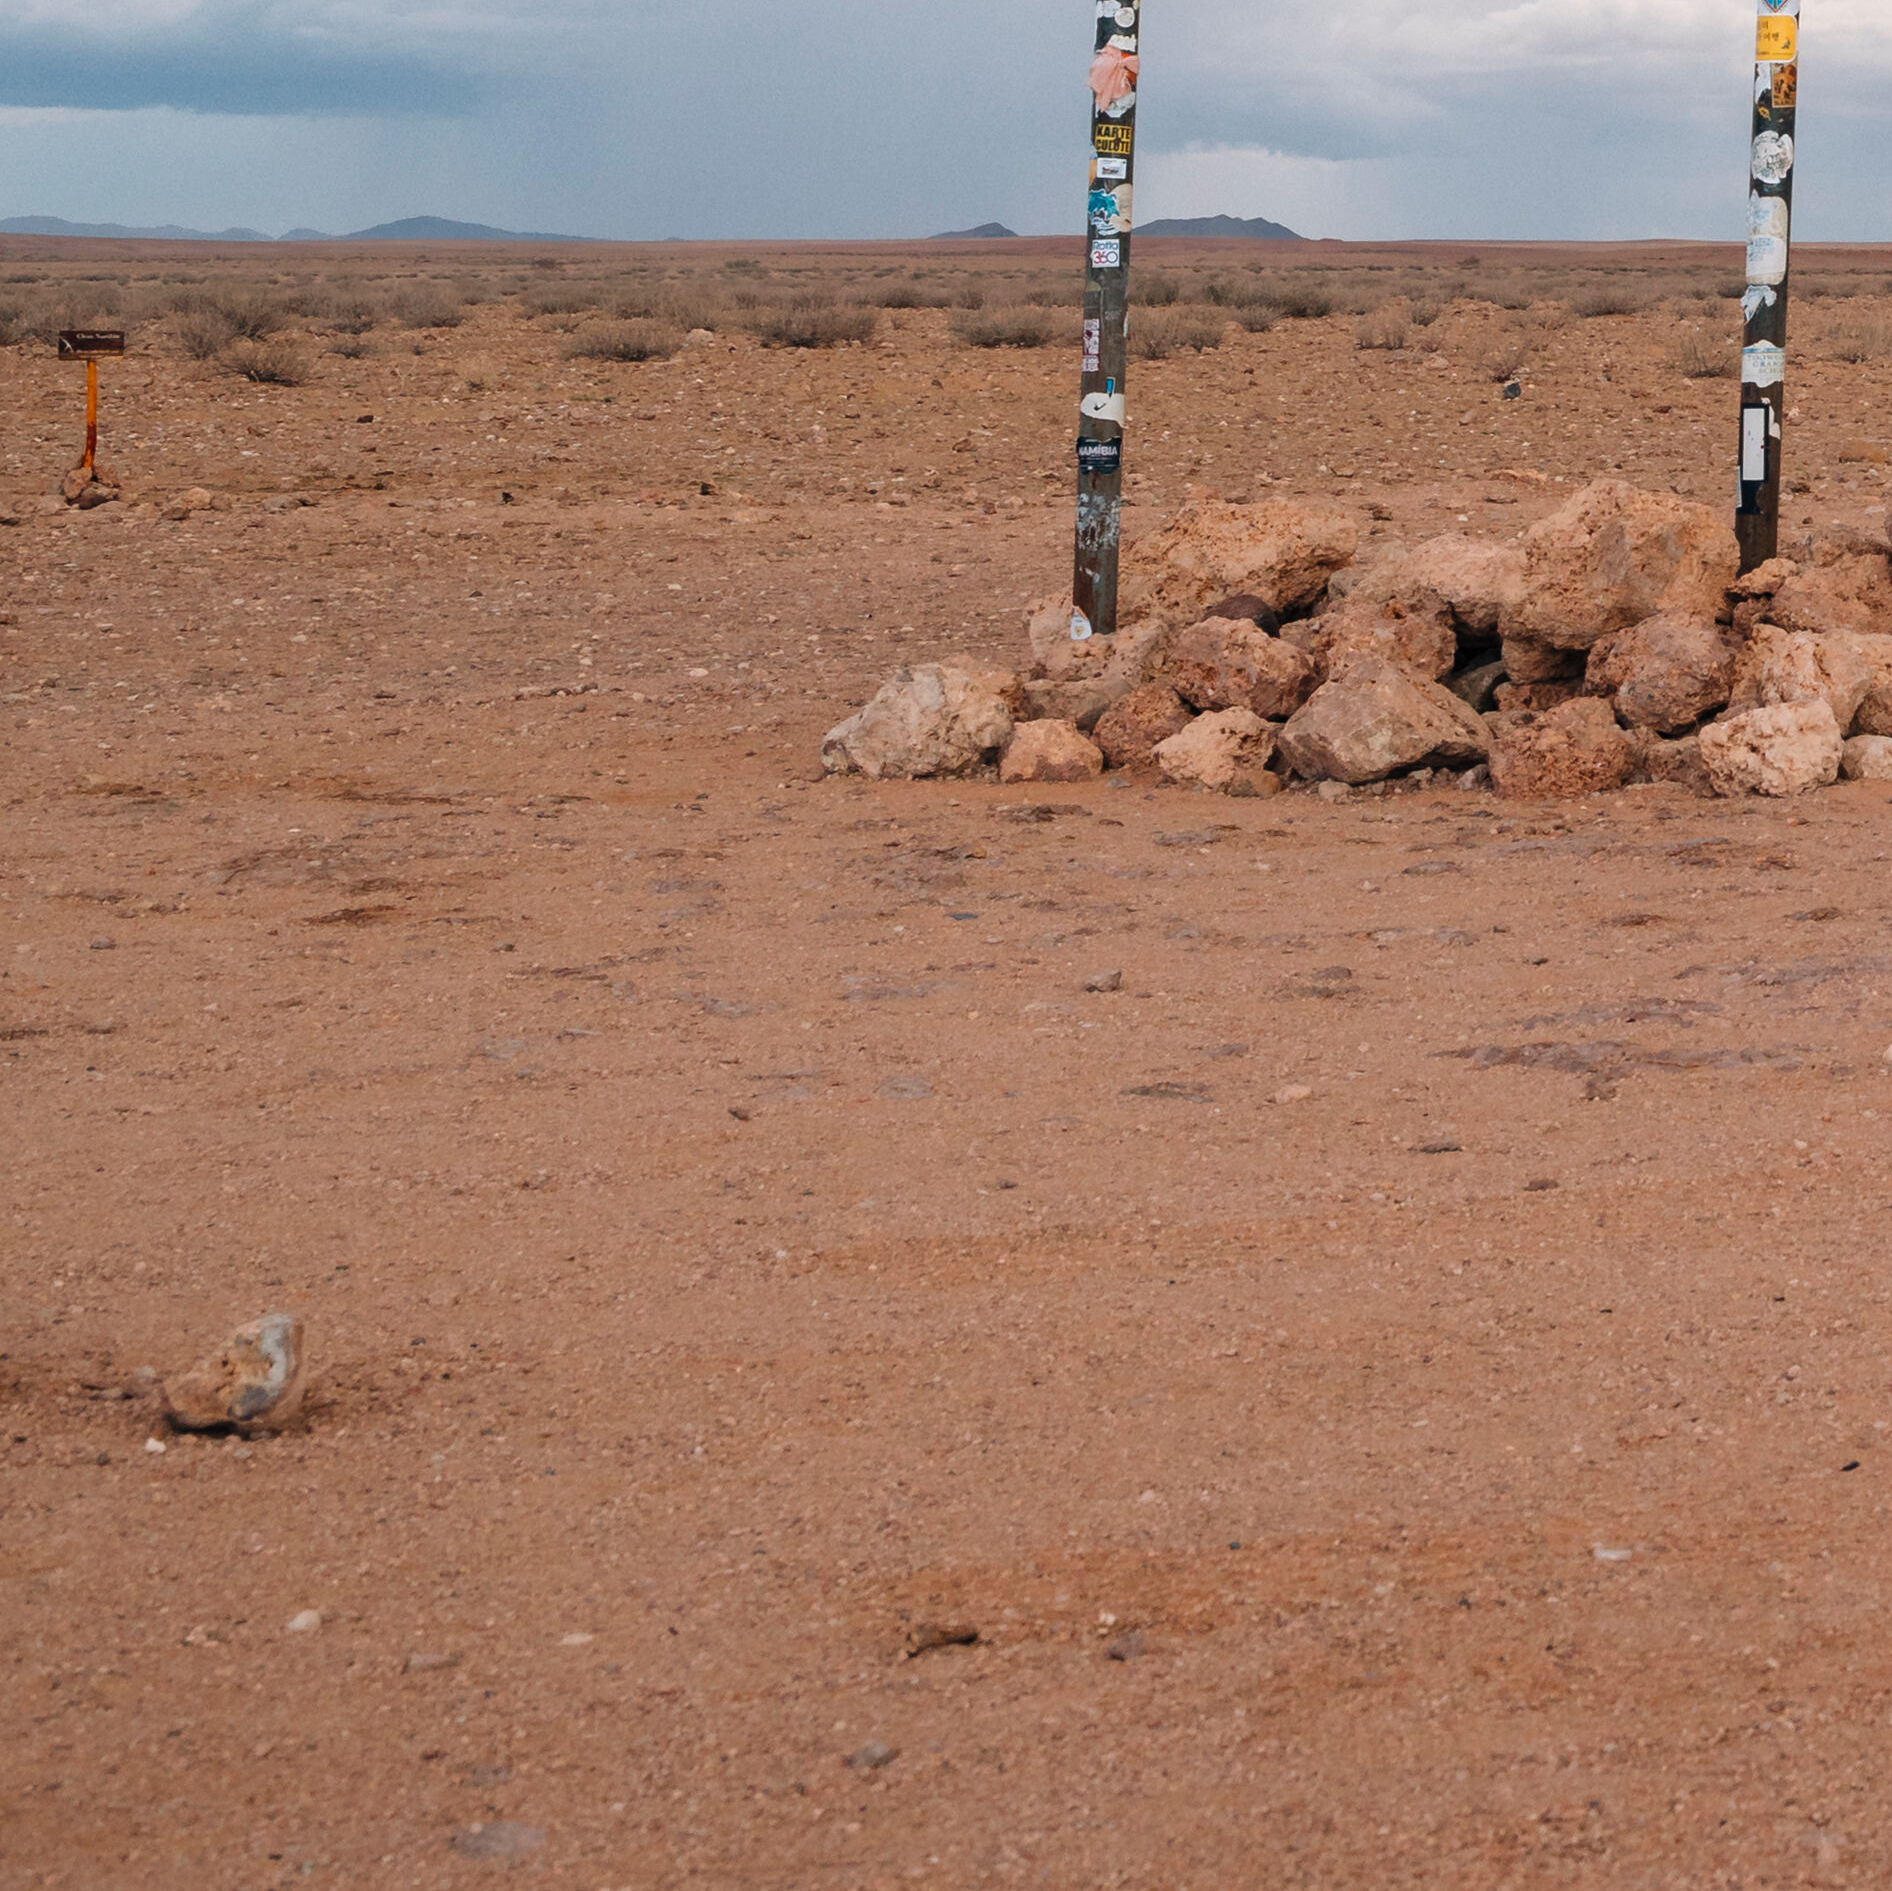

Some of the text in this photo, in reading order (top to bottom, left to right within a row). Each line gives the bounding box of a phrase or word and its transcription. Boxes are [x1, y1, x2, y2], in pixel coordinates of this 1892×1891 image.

[1097, 125, 1131, 139] KARTE
[1093, 241, 1119, 250] Rotta
[1093, 250, 1119, 264] 360
